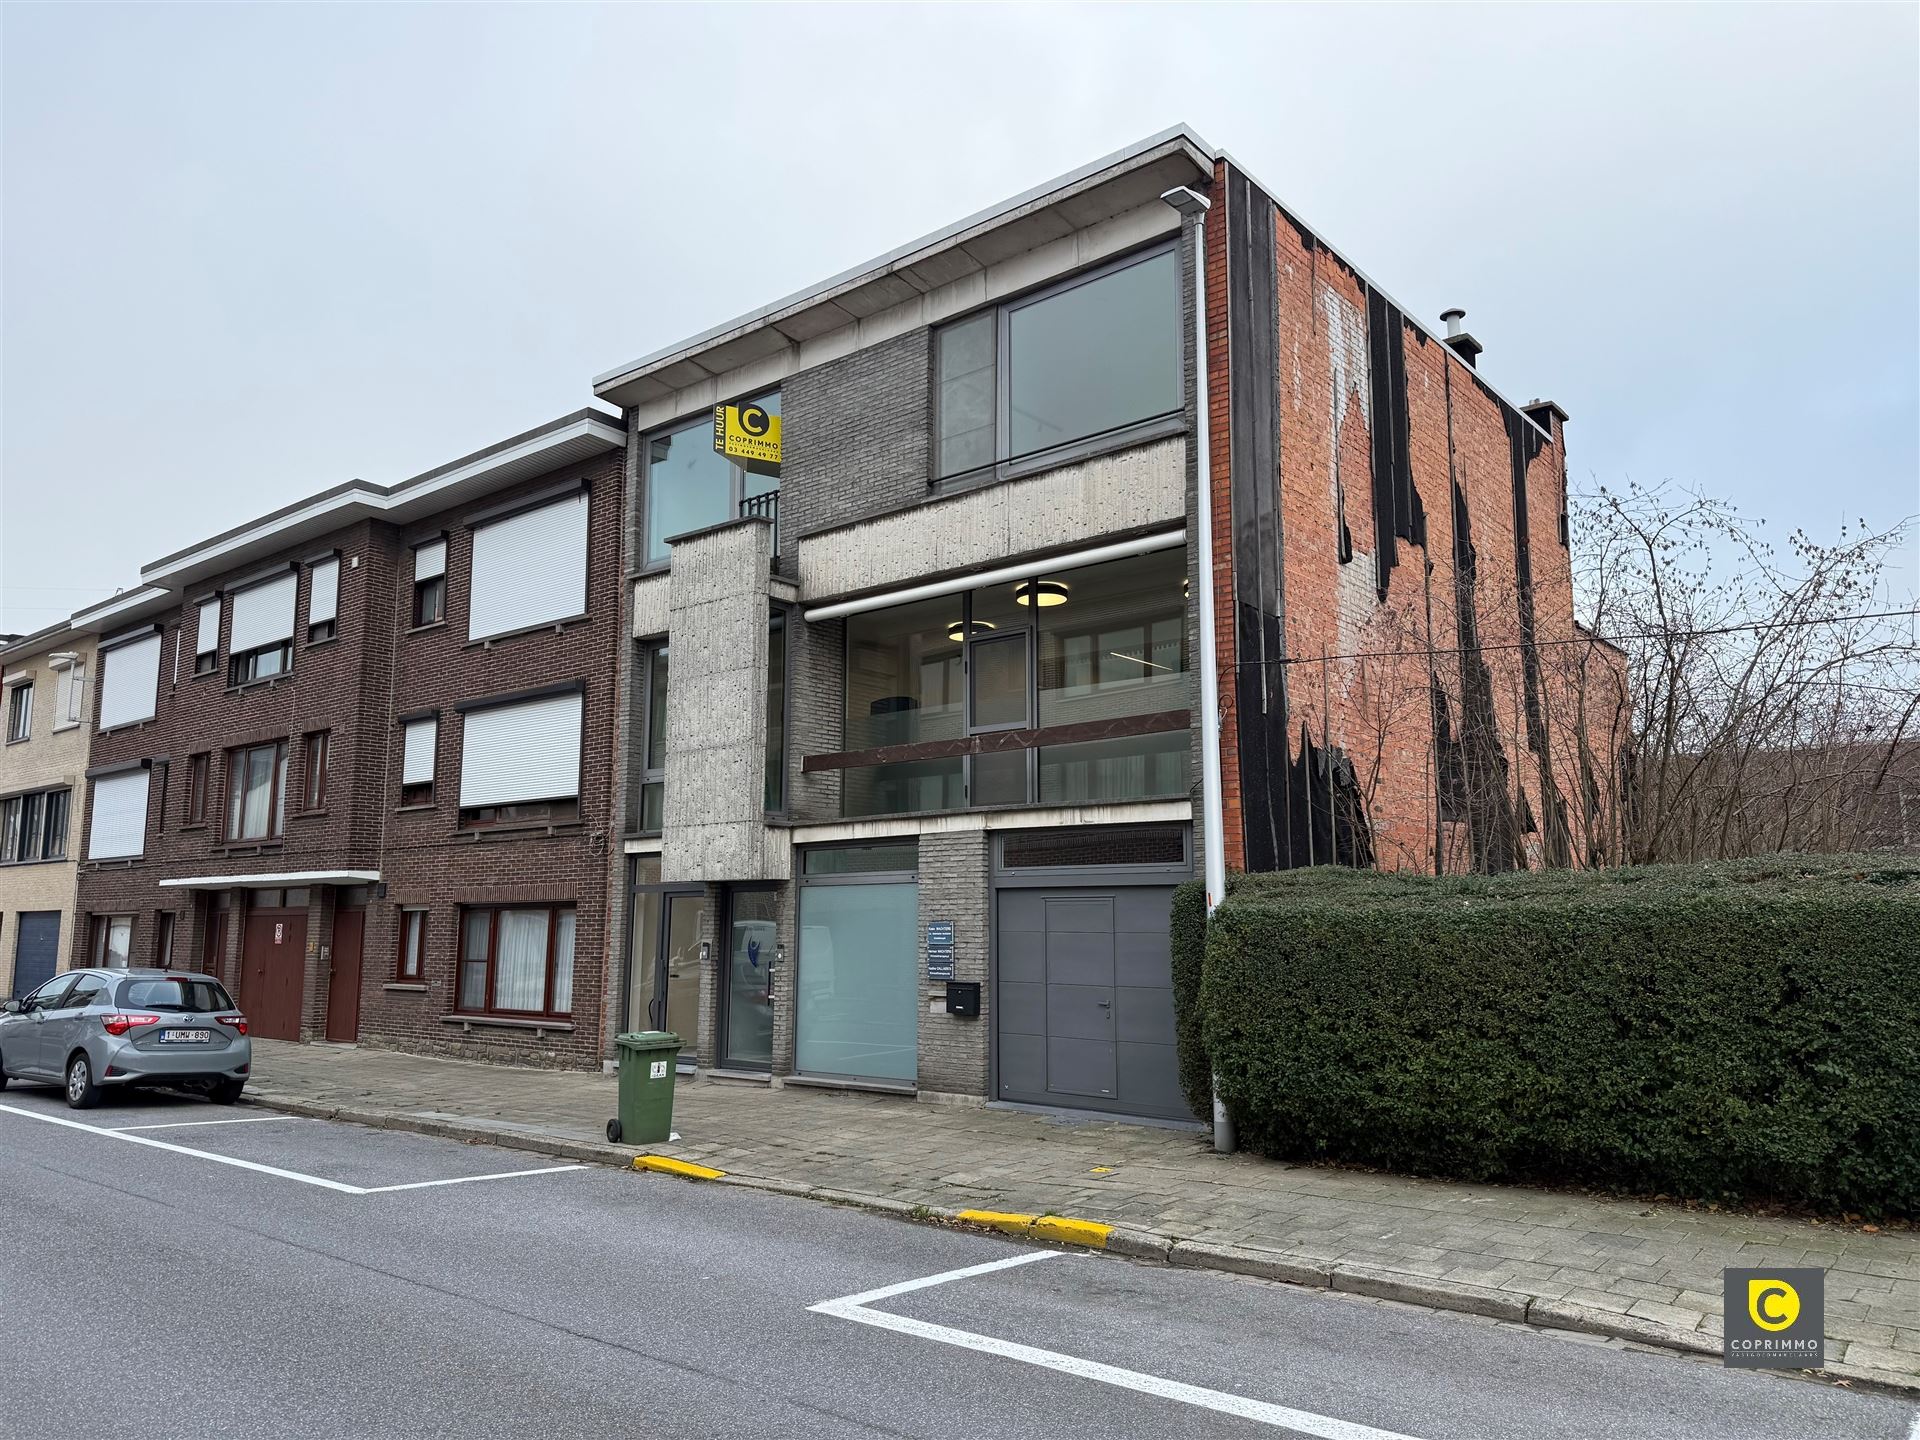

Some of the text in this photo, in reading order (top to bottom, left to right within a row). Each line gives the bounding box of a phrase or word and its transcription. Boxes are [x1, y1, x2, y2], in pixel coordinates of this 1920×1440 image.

[715, 406, 724, 450] TE HUUR
[729, 434, 779, 450] COPRIMMO
[741, 448, 755, 456] 449
